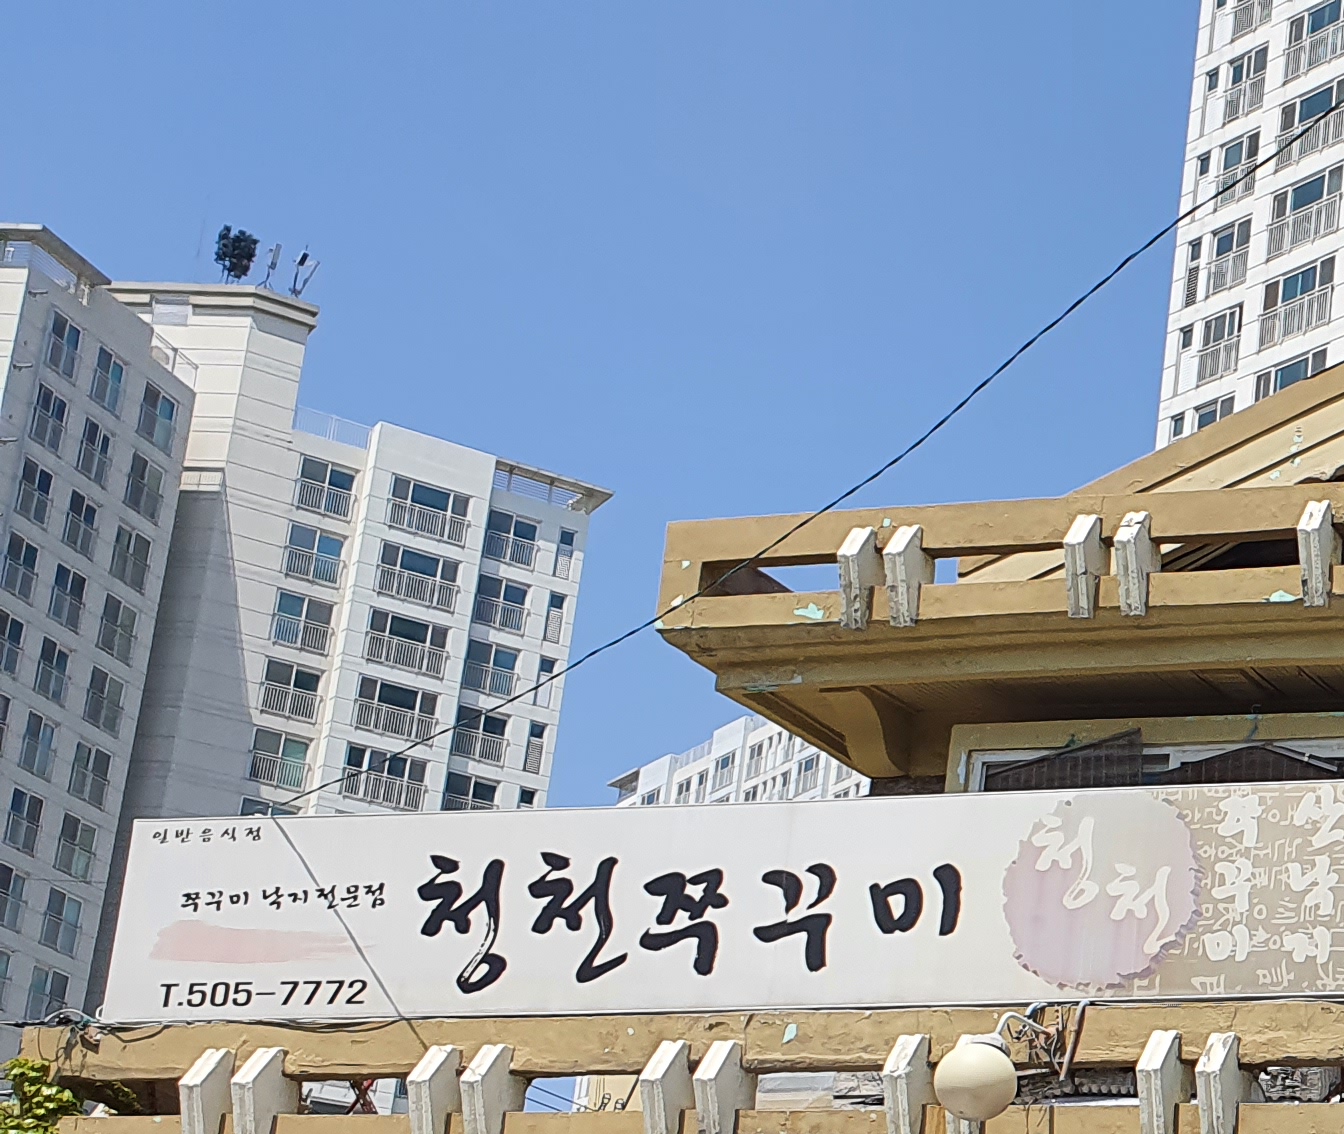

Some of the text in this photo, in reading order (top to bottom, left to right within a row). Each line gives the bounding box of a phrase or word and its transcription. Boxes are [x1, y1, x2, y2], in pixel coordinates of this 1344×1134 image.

[152, 826, 262, 844] 일반음식점
[261, 882, 386, 910] 낙지전문점
[1032, 815, 1185, 955] 청천
[160, 979, 368, 1008] T.505-7772
